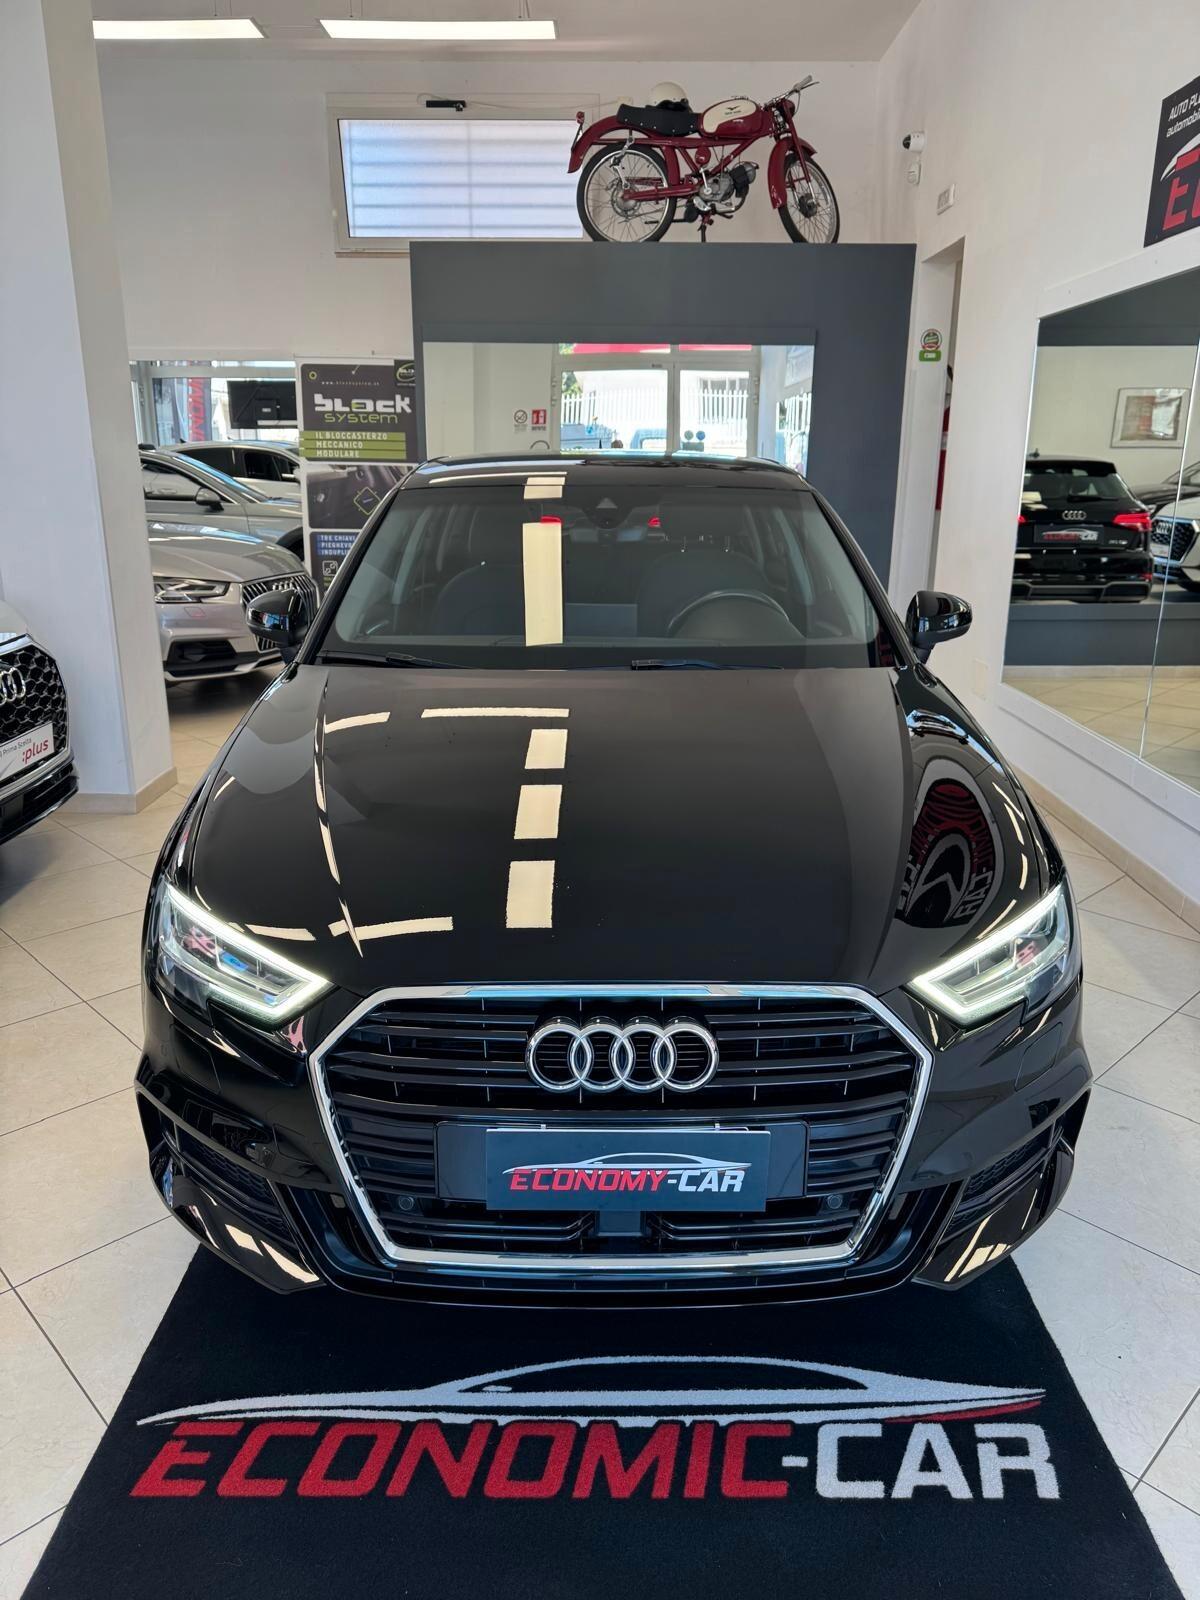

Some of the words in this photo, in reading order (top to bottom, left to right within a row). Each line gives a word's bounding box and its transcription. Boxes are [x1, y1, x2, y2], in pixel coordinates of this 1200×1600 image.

[1168, 98, 1189, 122] AUTO
[325, 432, 388, 440] BLOCCASTERZO
[316, 441, 363, 449] MECCANICO
[316, 450, 360, 458] MODULARE
[510, 1168, 745, 1192] ECONOMY-CAR
[131, 1420, 1060, 1500] ECONOMIC-CAR
